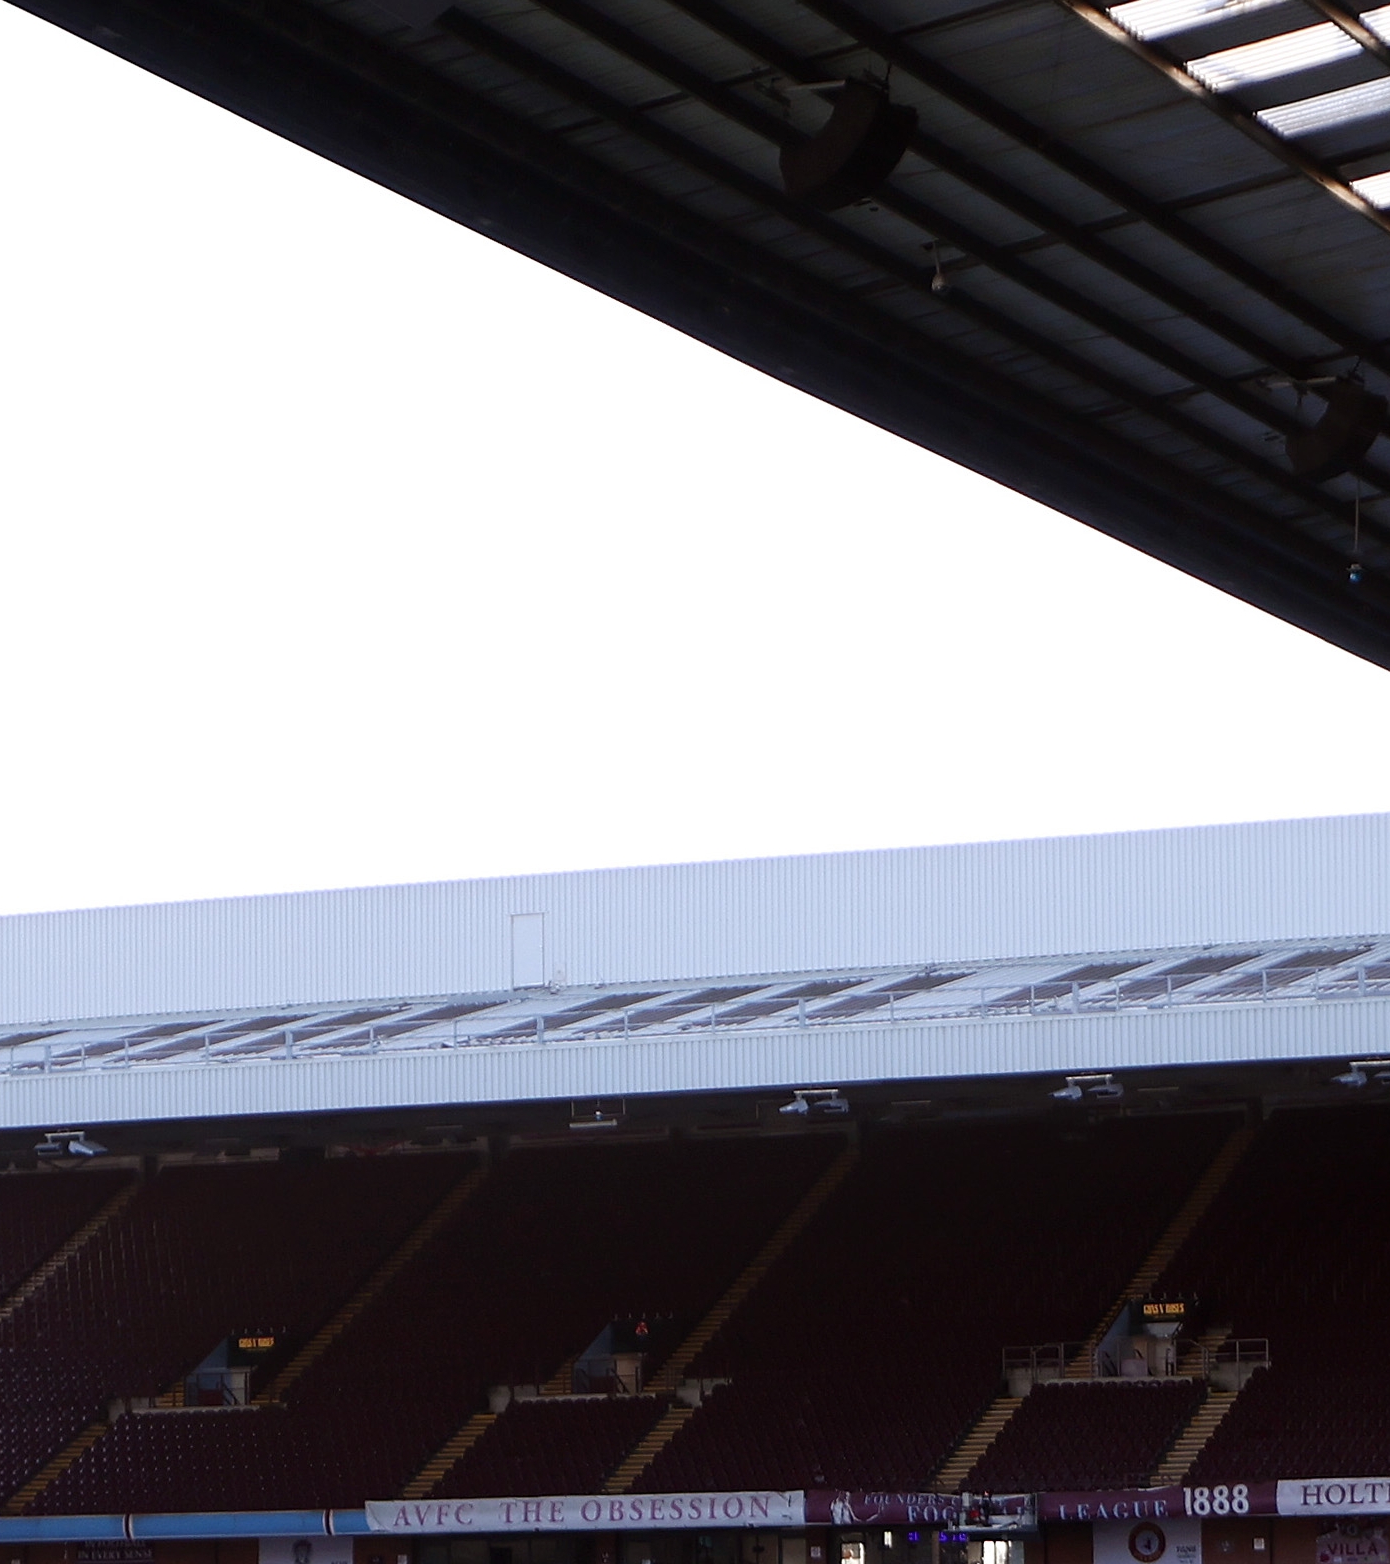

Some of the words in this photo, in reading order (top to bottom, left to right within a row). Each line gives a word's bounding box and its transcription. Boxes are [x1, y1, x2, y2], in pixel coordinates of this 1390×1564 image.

[393, 1502, 474, 1527] AVFC
[499, 1500, 565, 1524] THE
[580, 1495, 771, 1522] OBSESSION
[1058, 1499, 1169, 1521] LEAGUE
[1183, 1483, 1250, 1516] 1888
[1327, 1543, 1379, 1556] VILLA
